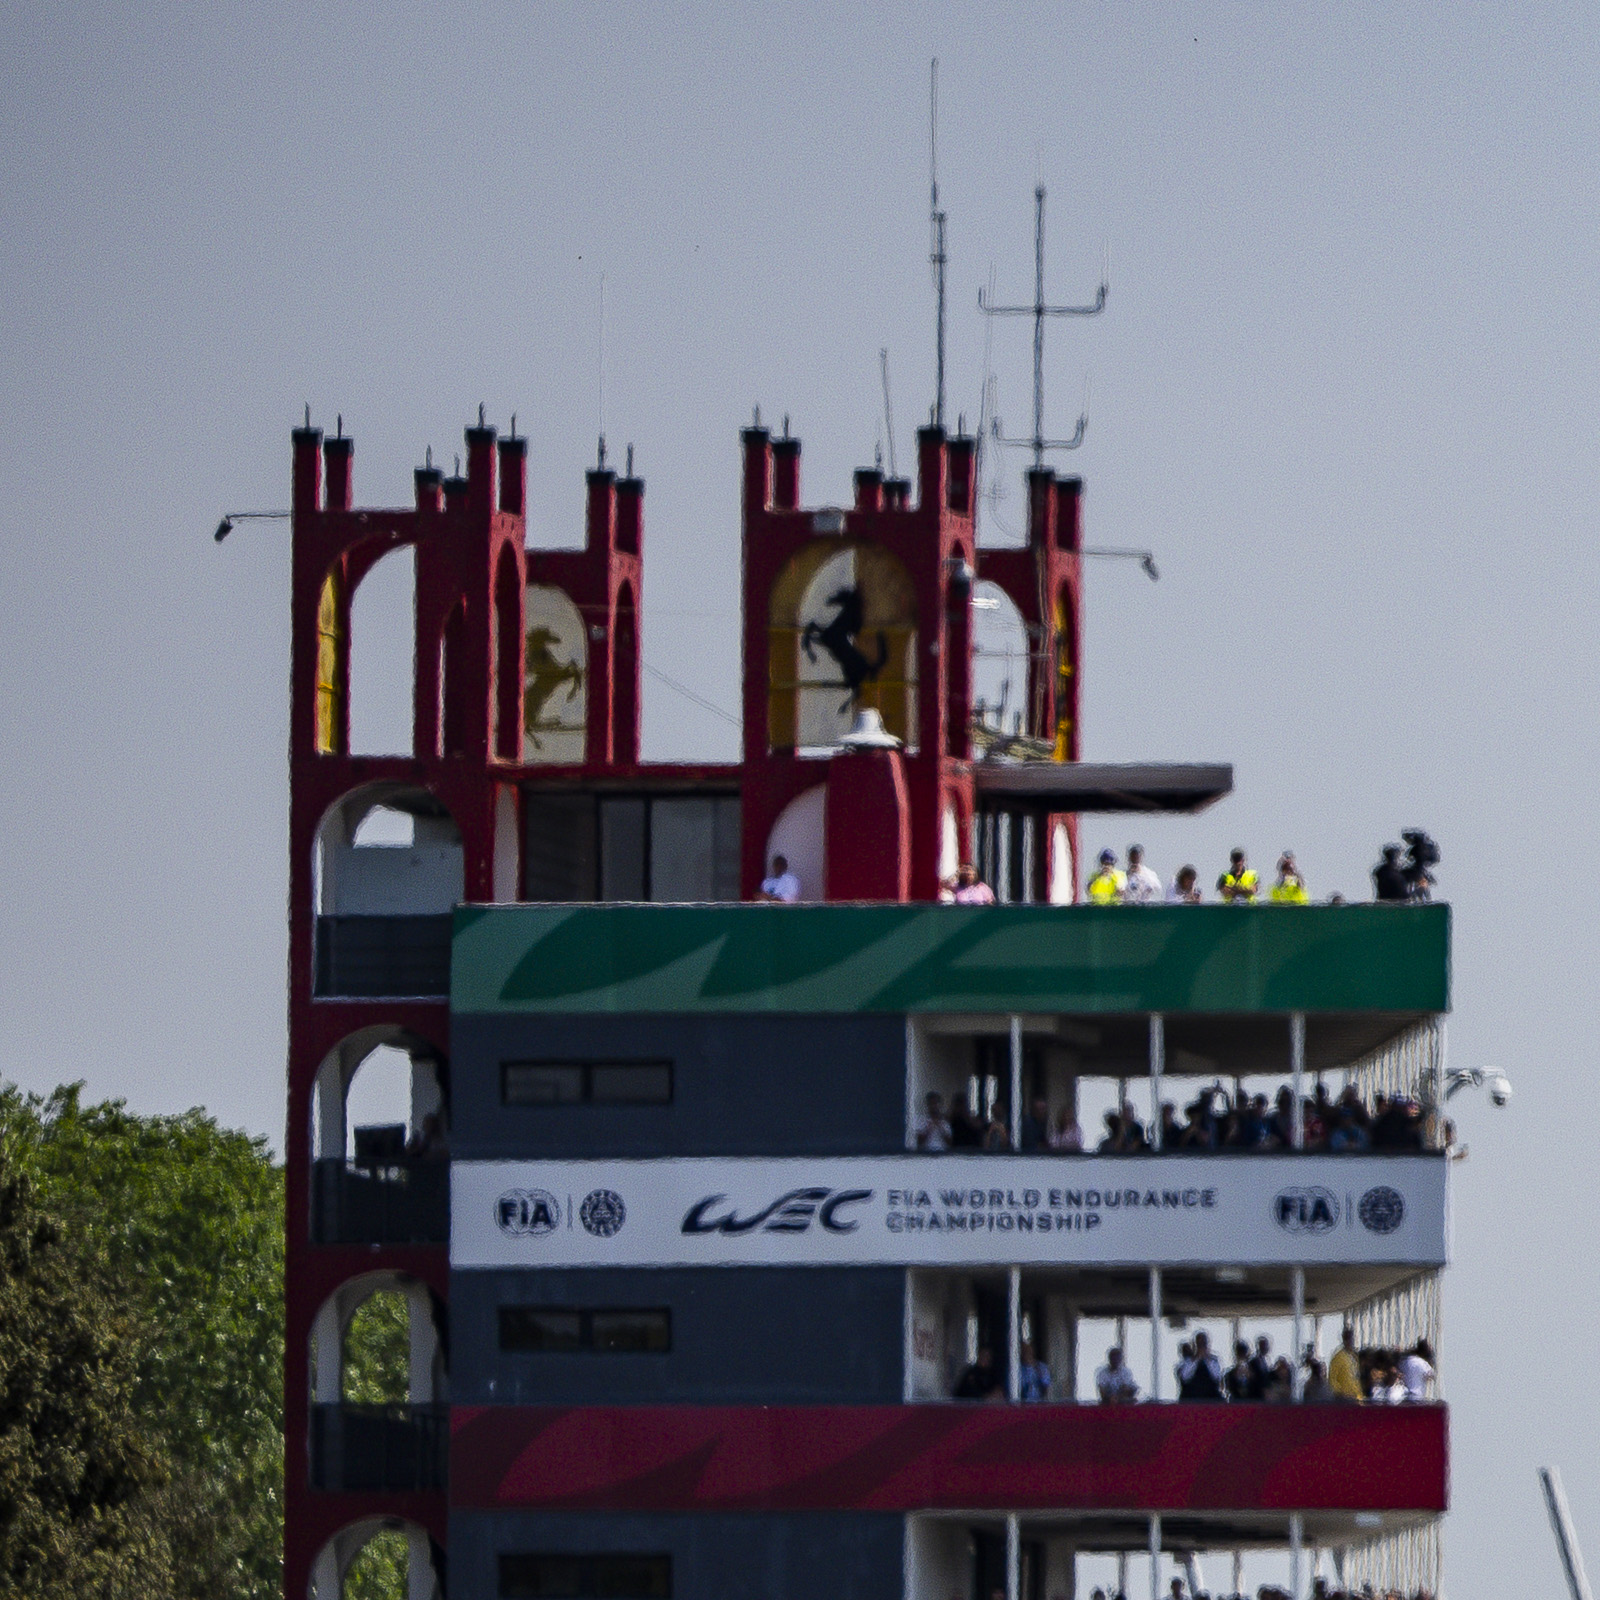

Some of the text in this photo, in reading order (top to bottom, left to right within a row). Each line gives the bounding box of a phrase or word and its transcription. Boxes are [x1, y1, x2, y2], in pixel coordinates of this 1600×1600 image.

[500, 1199, 550, 1226] FIA
[680, 1187, 872, 1235] WEC
[886, 1189, 1216, 1209] FIA WORLD ENDURANCE
[1280, 1196, 1332, 1224] FIA
[886, 1212, 1101, 1233] CHAMPIONSHIP
